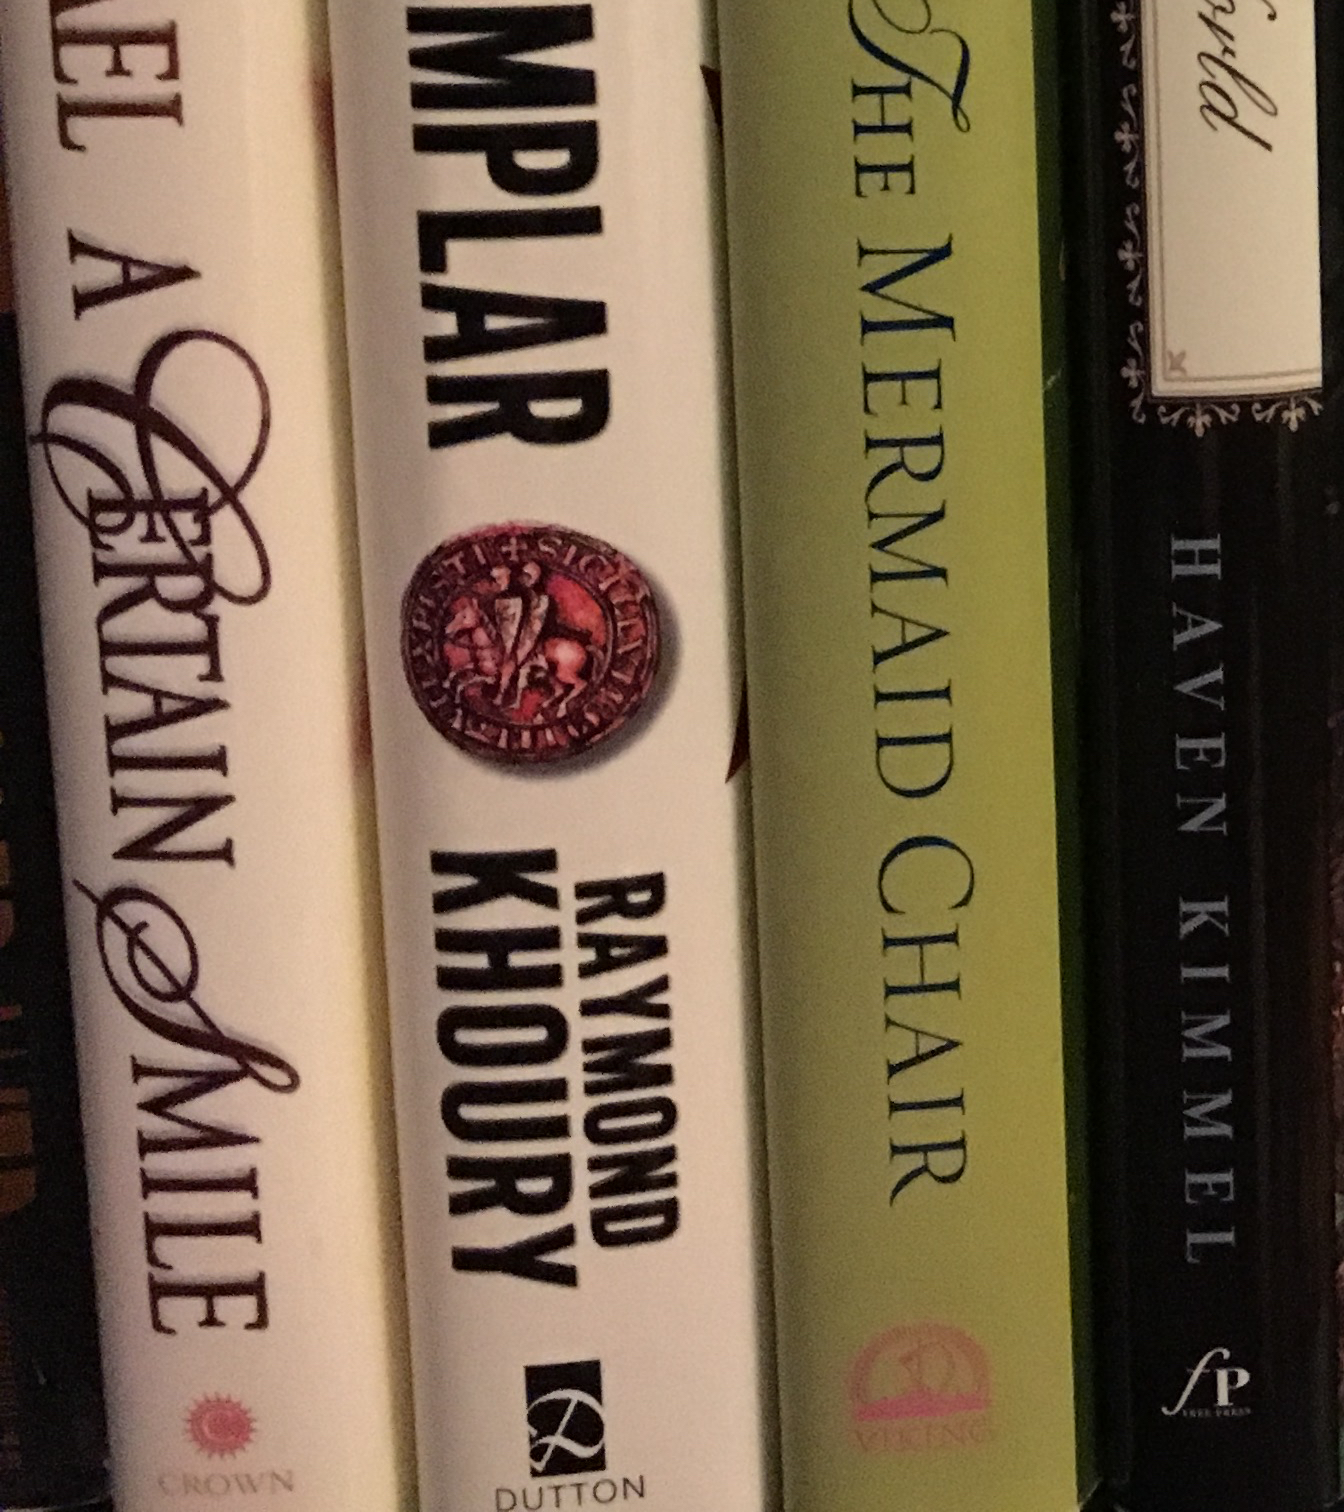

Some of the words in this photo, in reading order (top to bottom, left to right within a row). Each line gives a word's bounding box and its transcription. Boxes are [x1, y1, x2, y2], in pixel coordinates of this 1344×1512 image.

[66, 228, 201, 320] A
[30, 329, 272, 869] CERTAIN
[855, 233, 957, 799] MERMAID
[1170, 533, 1229, 836] HAVEN
[72, 877, 300, 1336] SMILE
[430, 848, 580, 1289] KHOURY
[575, 871, 681, 1250] RAYMOND
[876, 834, 975, 1207] CHAIR
[1178, 895, 1236, 1265] KIMMEL
[158, 1468, 294, 1496] CROWN
[495, 1474, 645, 1512] DUTTON
